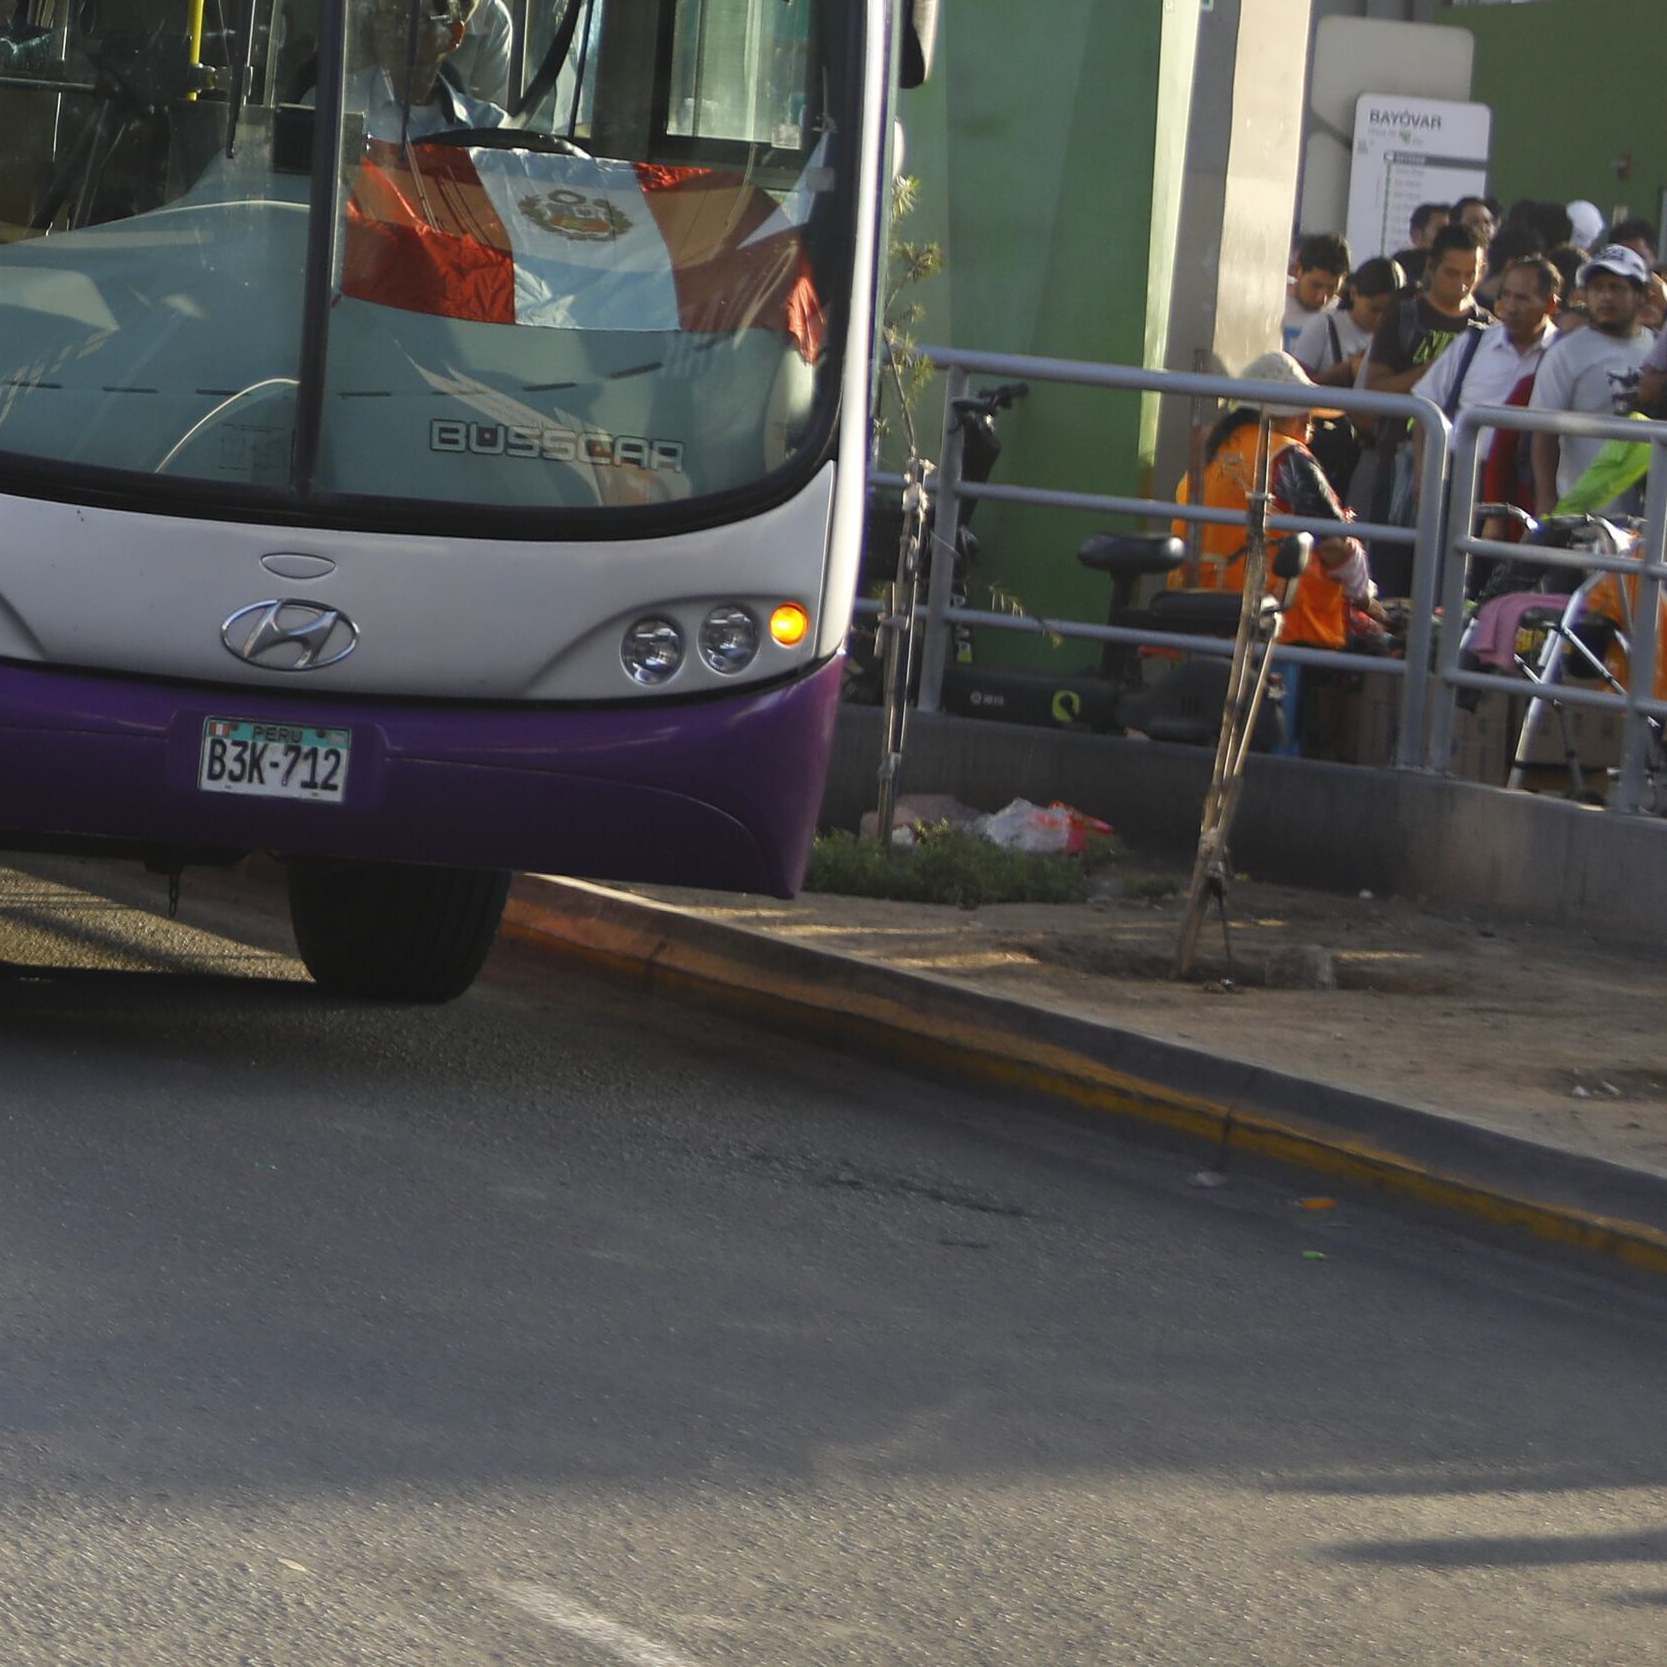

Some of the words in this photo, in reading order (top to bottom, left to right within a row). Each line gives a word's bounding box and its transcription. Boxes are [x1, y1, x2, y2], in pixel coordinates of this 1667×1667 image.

[429, 418, 684, 473] BUSSCAR
[251, 725, 303, 743] PERU
[207, 738, 341, 791] B3K-712
